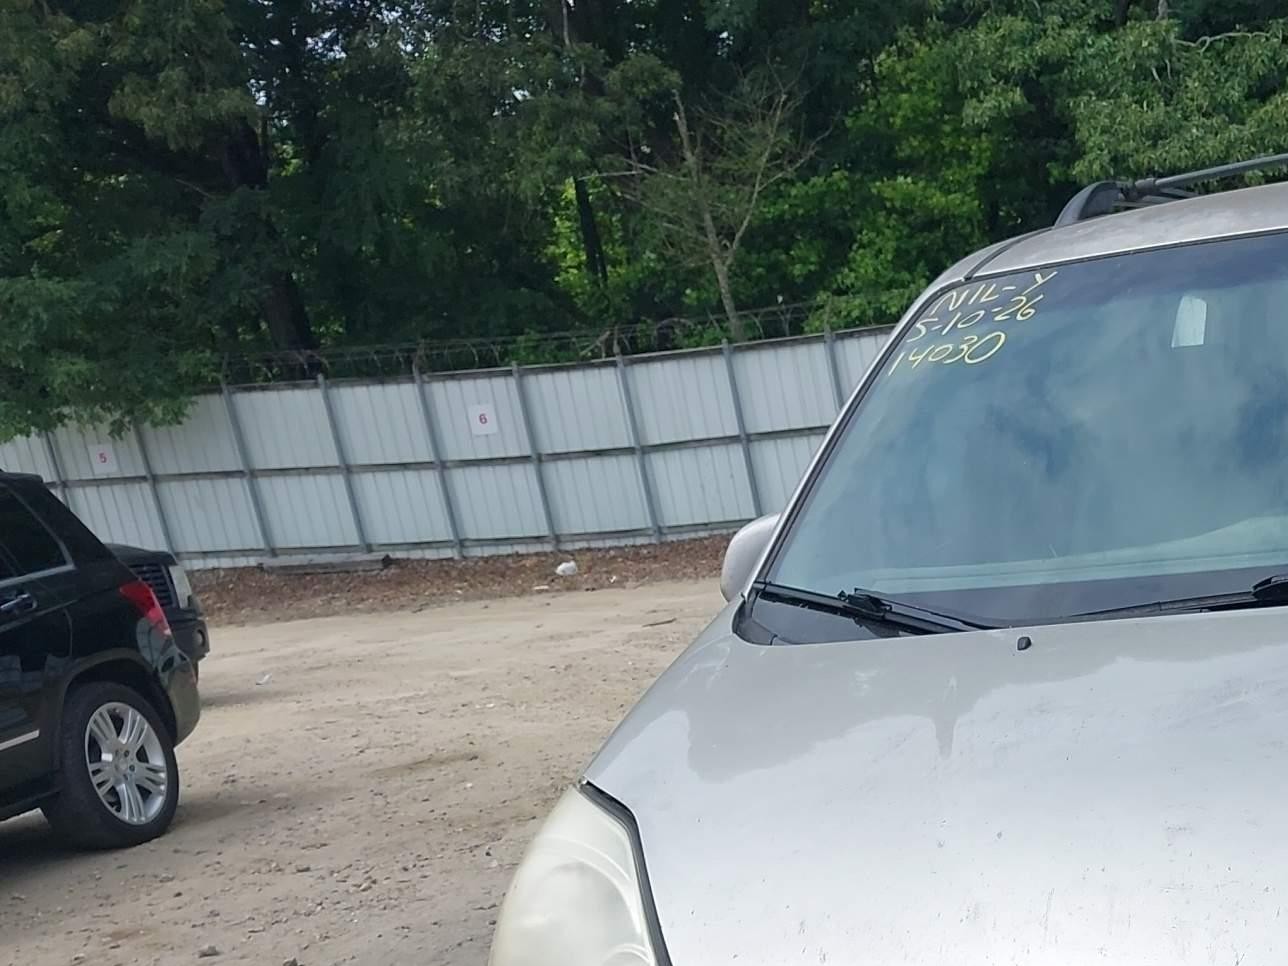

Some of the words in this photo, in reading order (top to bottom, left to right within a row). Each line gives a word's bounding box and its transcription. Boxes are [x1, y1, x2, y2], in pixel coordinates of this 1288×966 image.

[906, 294, 1044, 343] 5-10-26
[888, 331, 1006, 376] 14030
[479, 413, 488, 425] 6
[99, 452, 108, 464] 5
